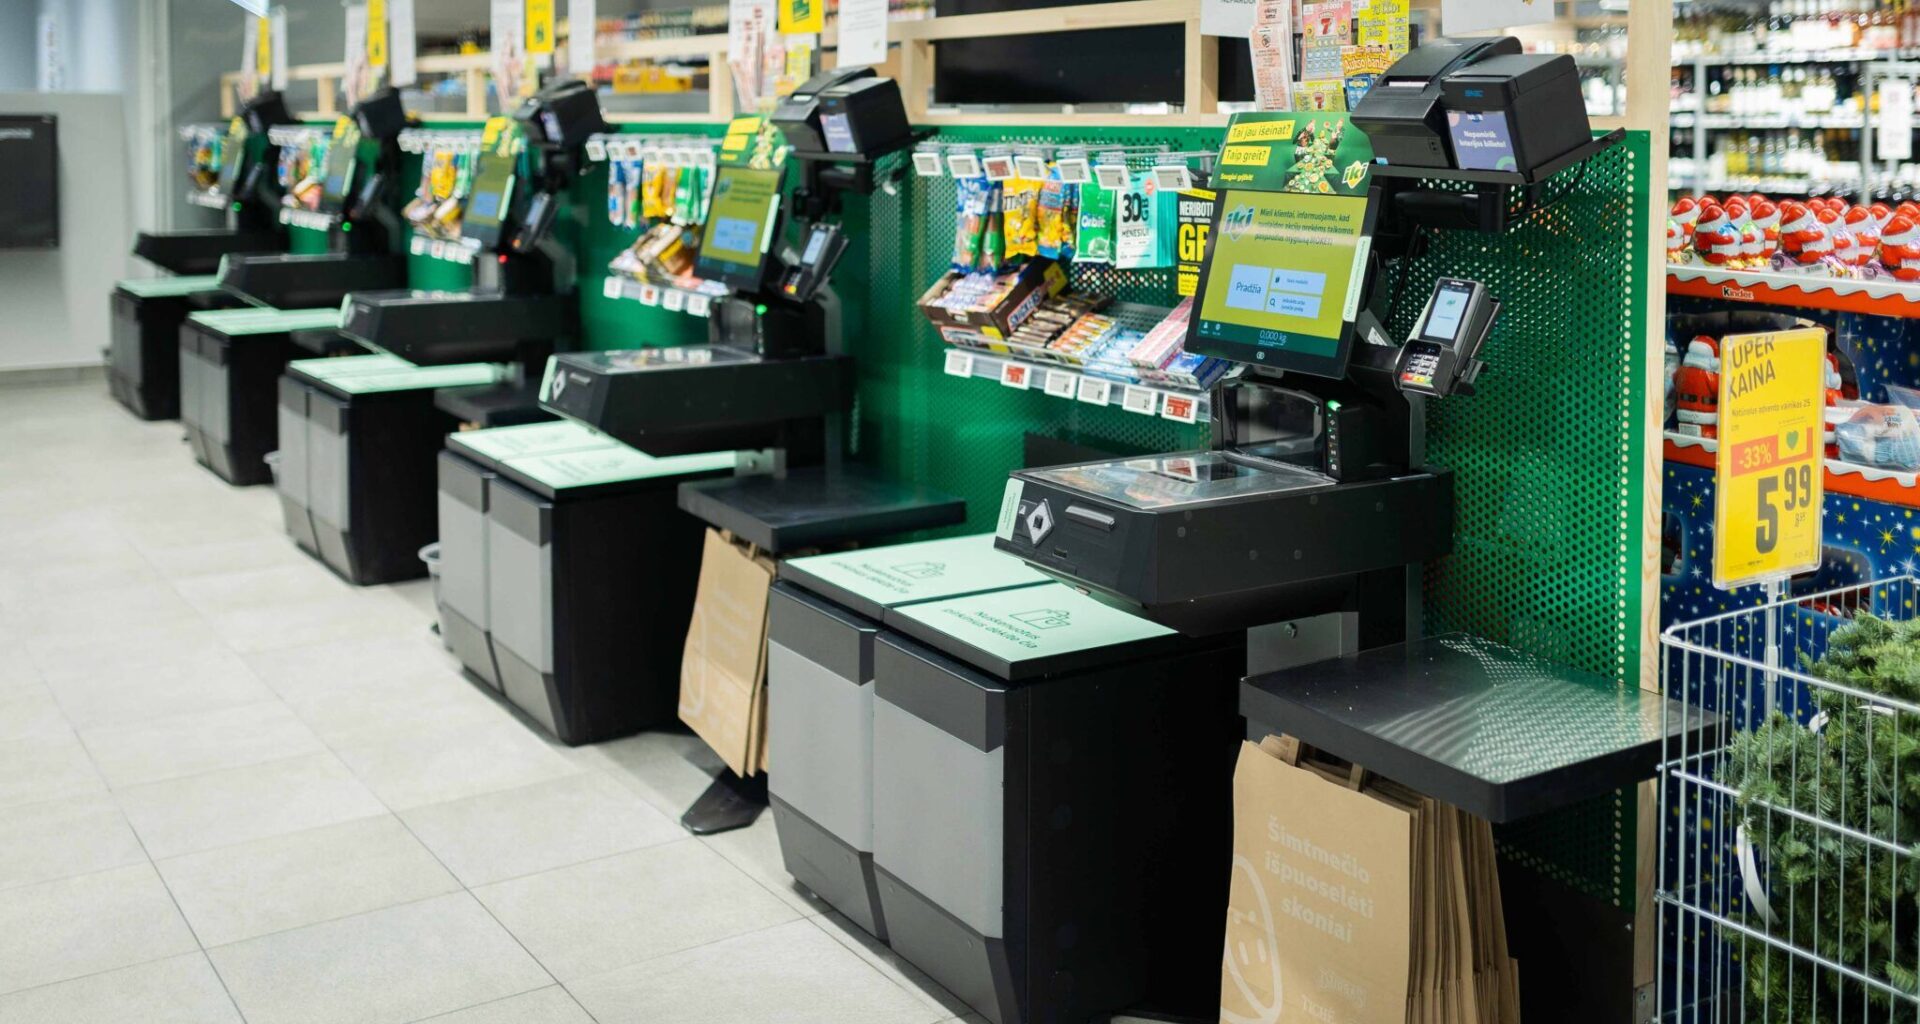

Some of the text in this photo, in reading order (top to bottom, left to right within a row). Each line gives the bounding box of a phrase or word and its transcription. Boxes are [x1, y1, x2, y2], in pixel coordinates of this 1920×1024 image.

[1232, 124, 1291, 139] Tai jau išeinat?
[1226, 149, 1267, 162] Taip greit?
[1122, 192, 1142, 223] 30
[1224, 207, 1255, 233] iki
[1081, 213, 1106, 229] Orbit
[1236, 281, 1262, 294] Pradžia
[1731, 335, 1776, 369] UPER
[1730, 359, 1776, 399] KAINA
[1738, 443, 1773, 469] -33%
[1281, 896, 1353, 944] skoniai
